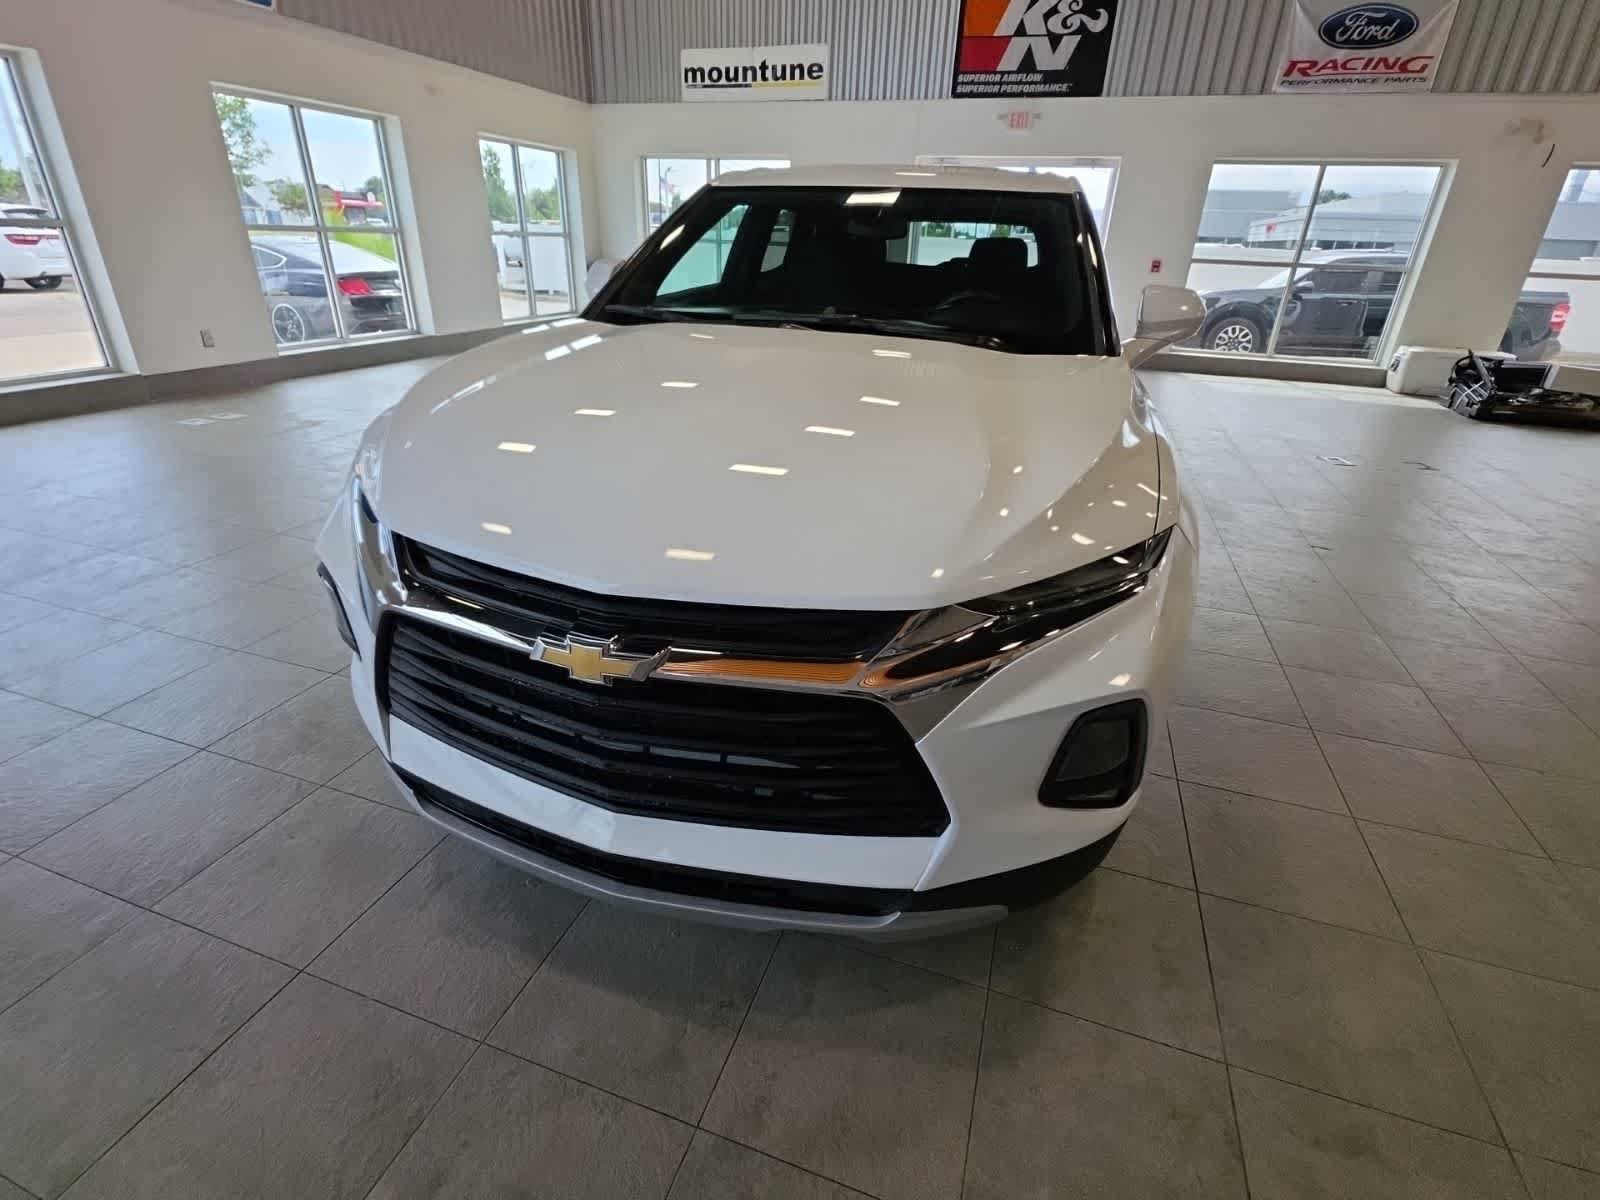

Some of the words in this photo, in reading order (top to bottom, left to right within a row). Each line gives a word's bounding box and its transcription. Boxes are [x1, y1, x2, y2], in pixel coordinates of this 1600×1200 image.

[1335, 11, 1399, 42] Ford
[684, 59, 824, 84] mountune
[1283, 55, 1435, 78] RACING
[957, 73, 1001, 83] SUPERIOR
[1280, 77, 1380, 86] PERFORMANCE
[956, 84, 1000, 93] SUPERIOR
[1010, 111, 1030, 129] EXIT
